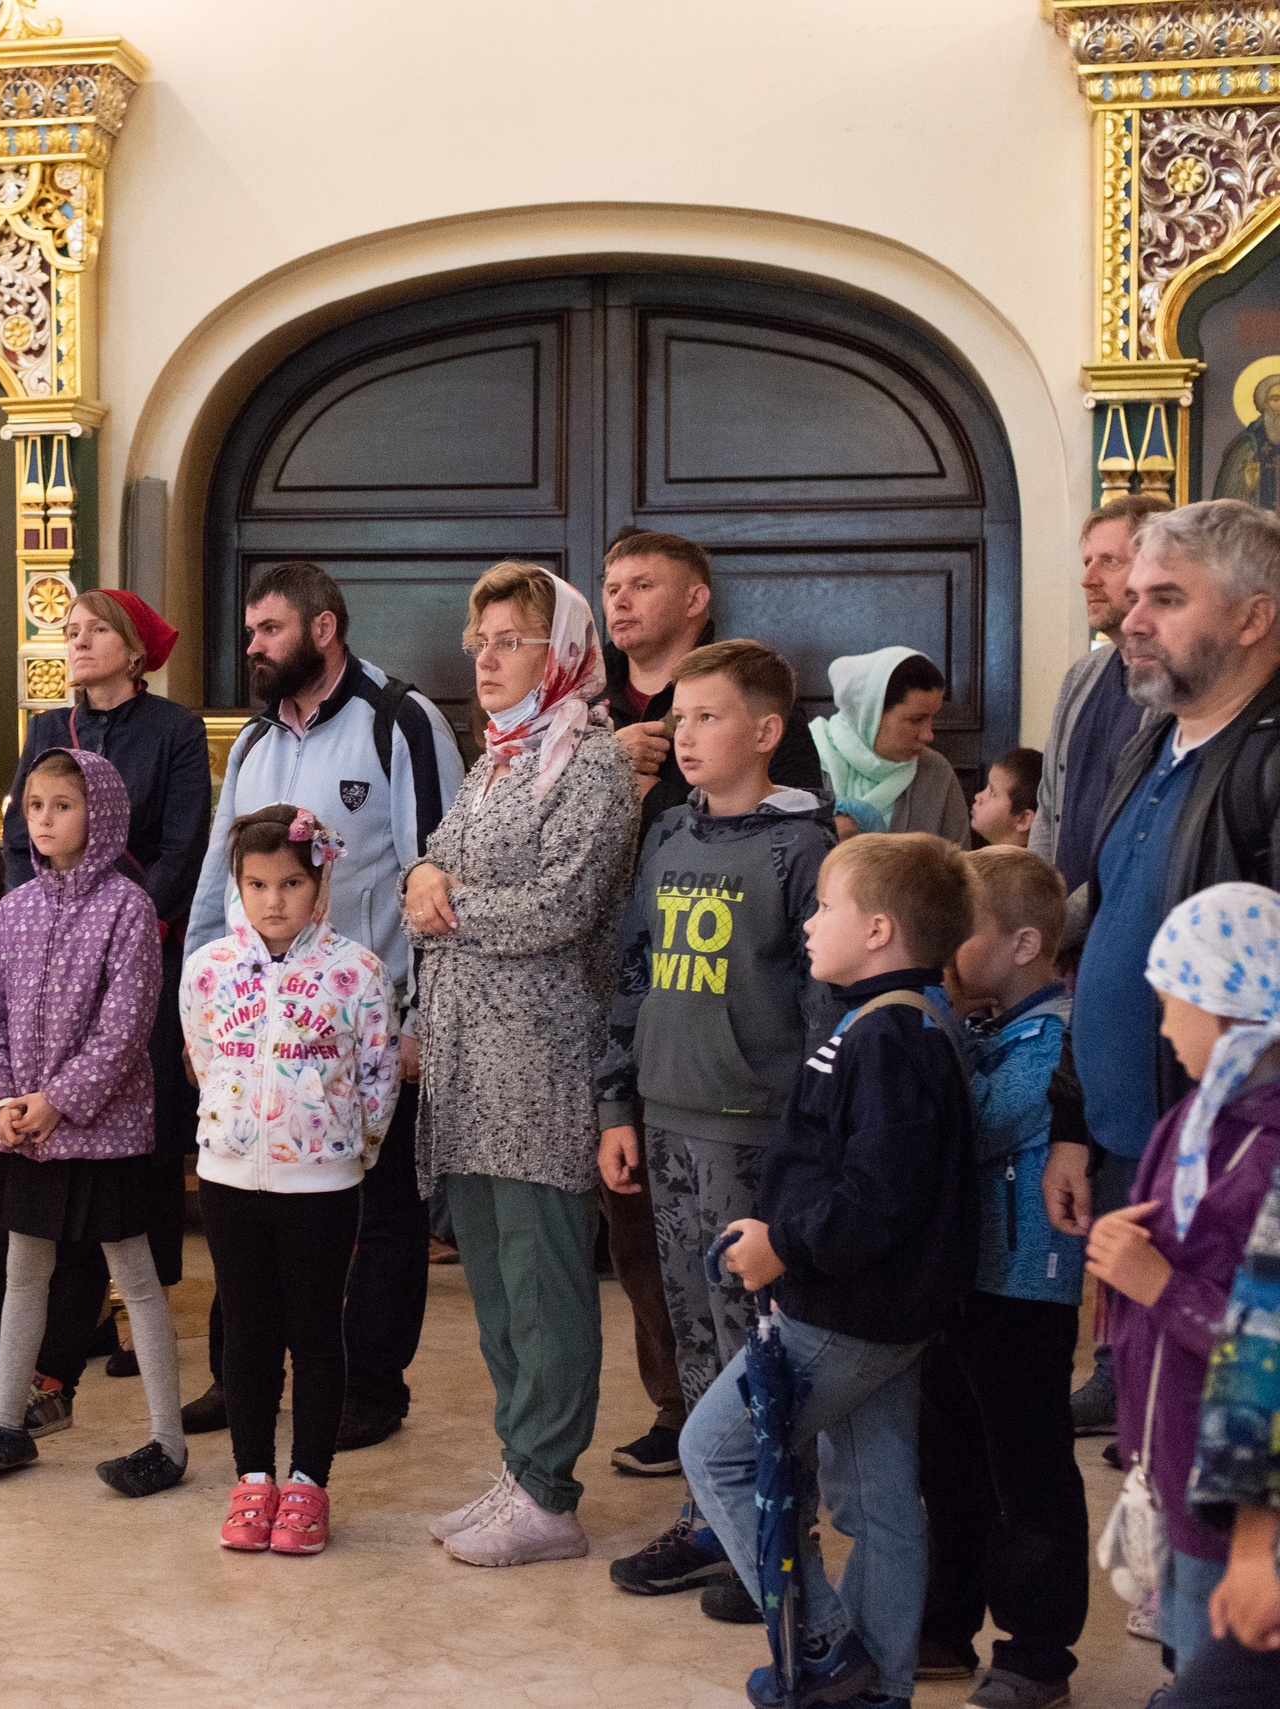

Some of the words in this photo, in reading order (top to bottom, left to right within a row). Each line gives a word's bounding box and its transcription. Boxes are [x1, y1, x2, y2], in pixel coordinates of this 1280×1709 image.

[659, 870, 744, 900] BORN
[656, 896, 733, 953] TO
[652, 952, 729, 995] WIN
